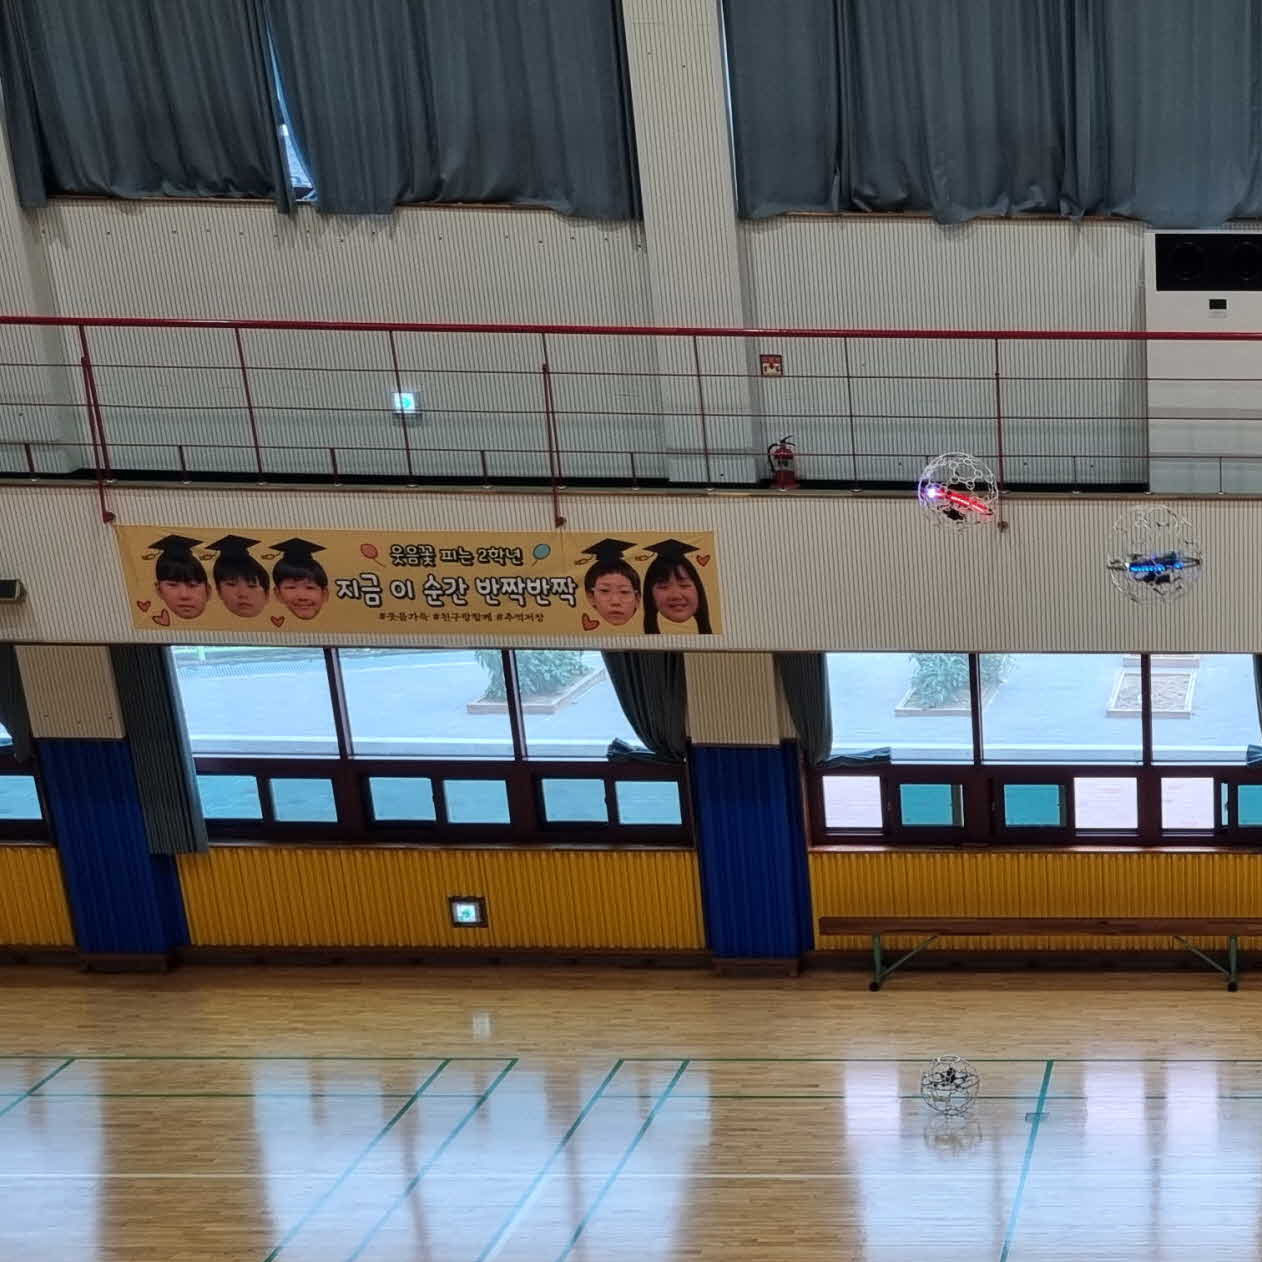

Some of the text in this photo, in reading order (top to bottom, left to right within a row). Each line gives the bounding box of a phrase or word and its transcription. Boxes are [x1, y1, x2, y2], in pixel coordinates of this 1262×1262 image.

[389, 543, 523, 567] 웃음꽃 피는 2학년
[335, 572, 577, 607] 지금 이 순간 반짝반짝
